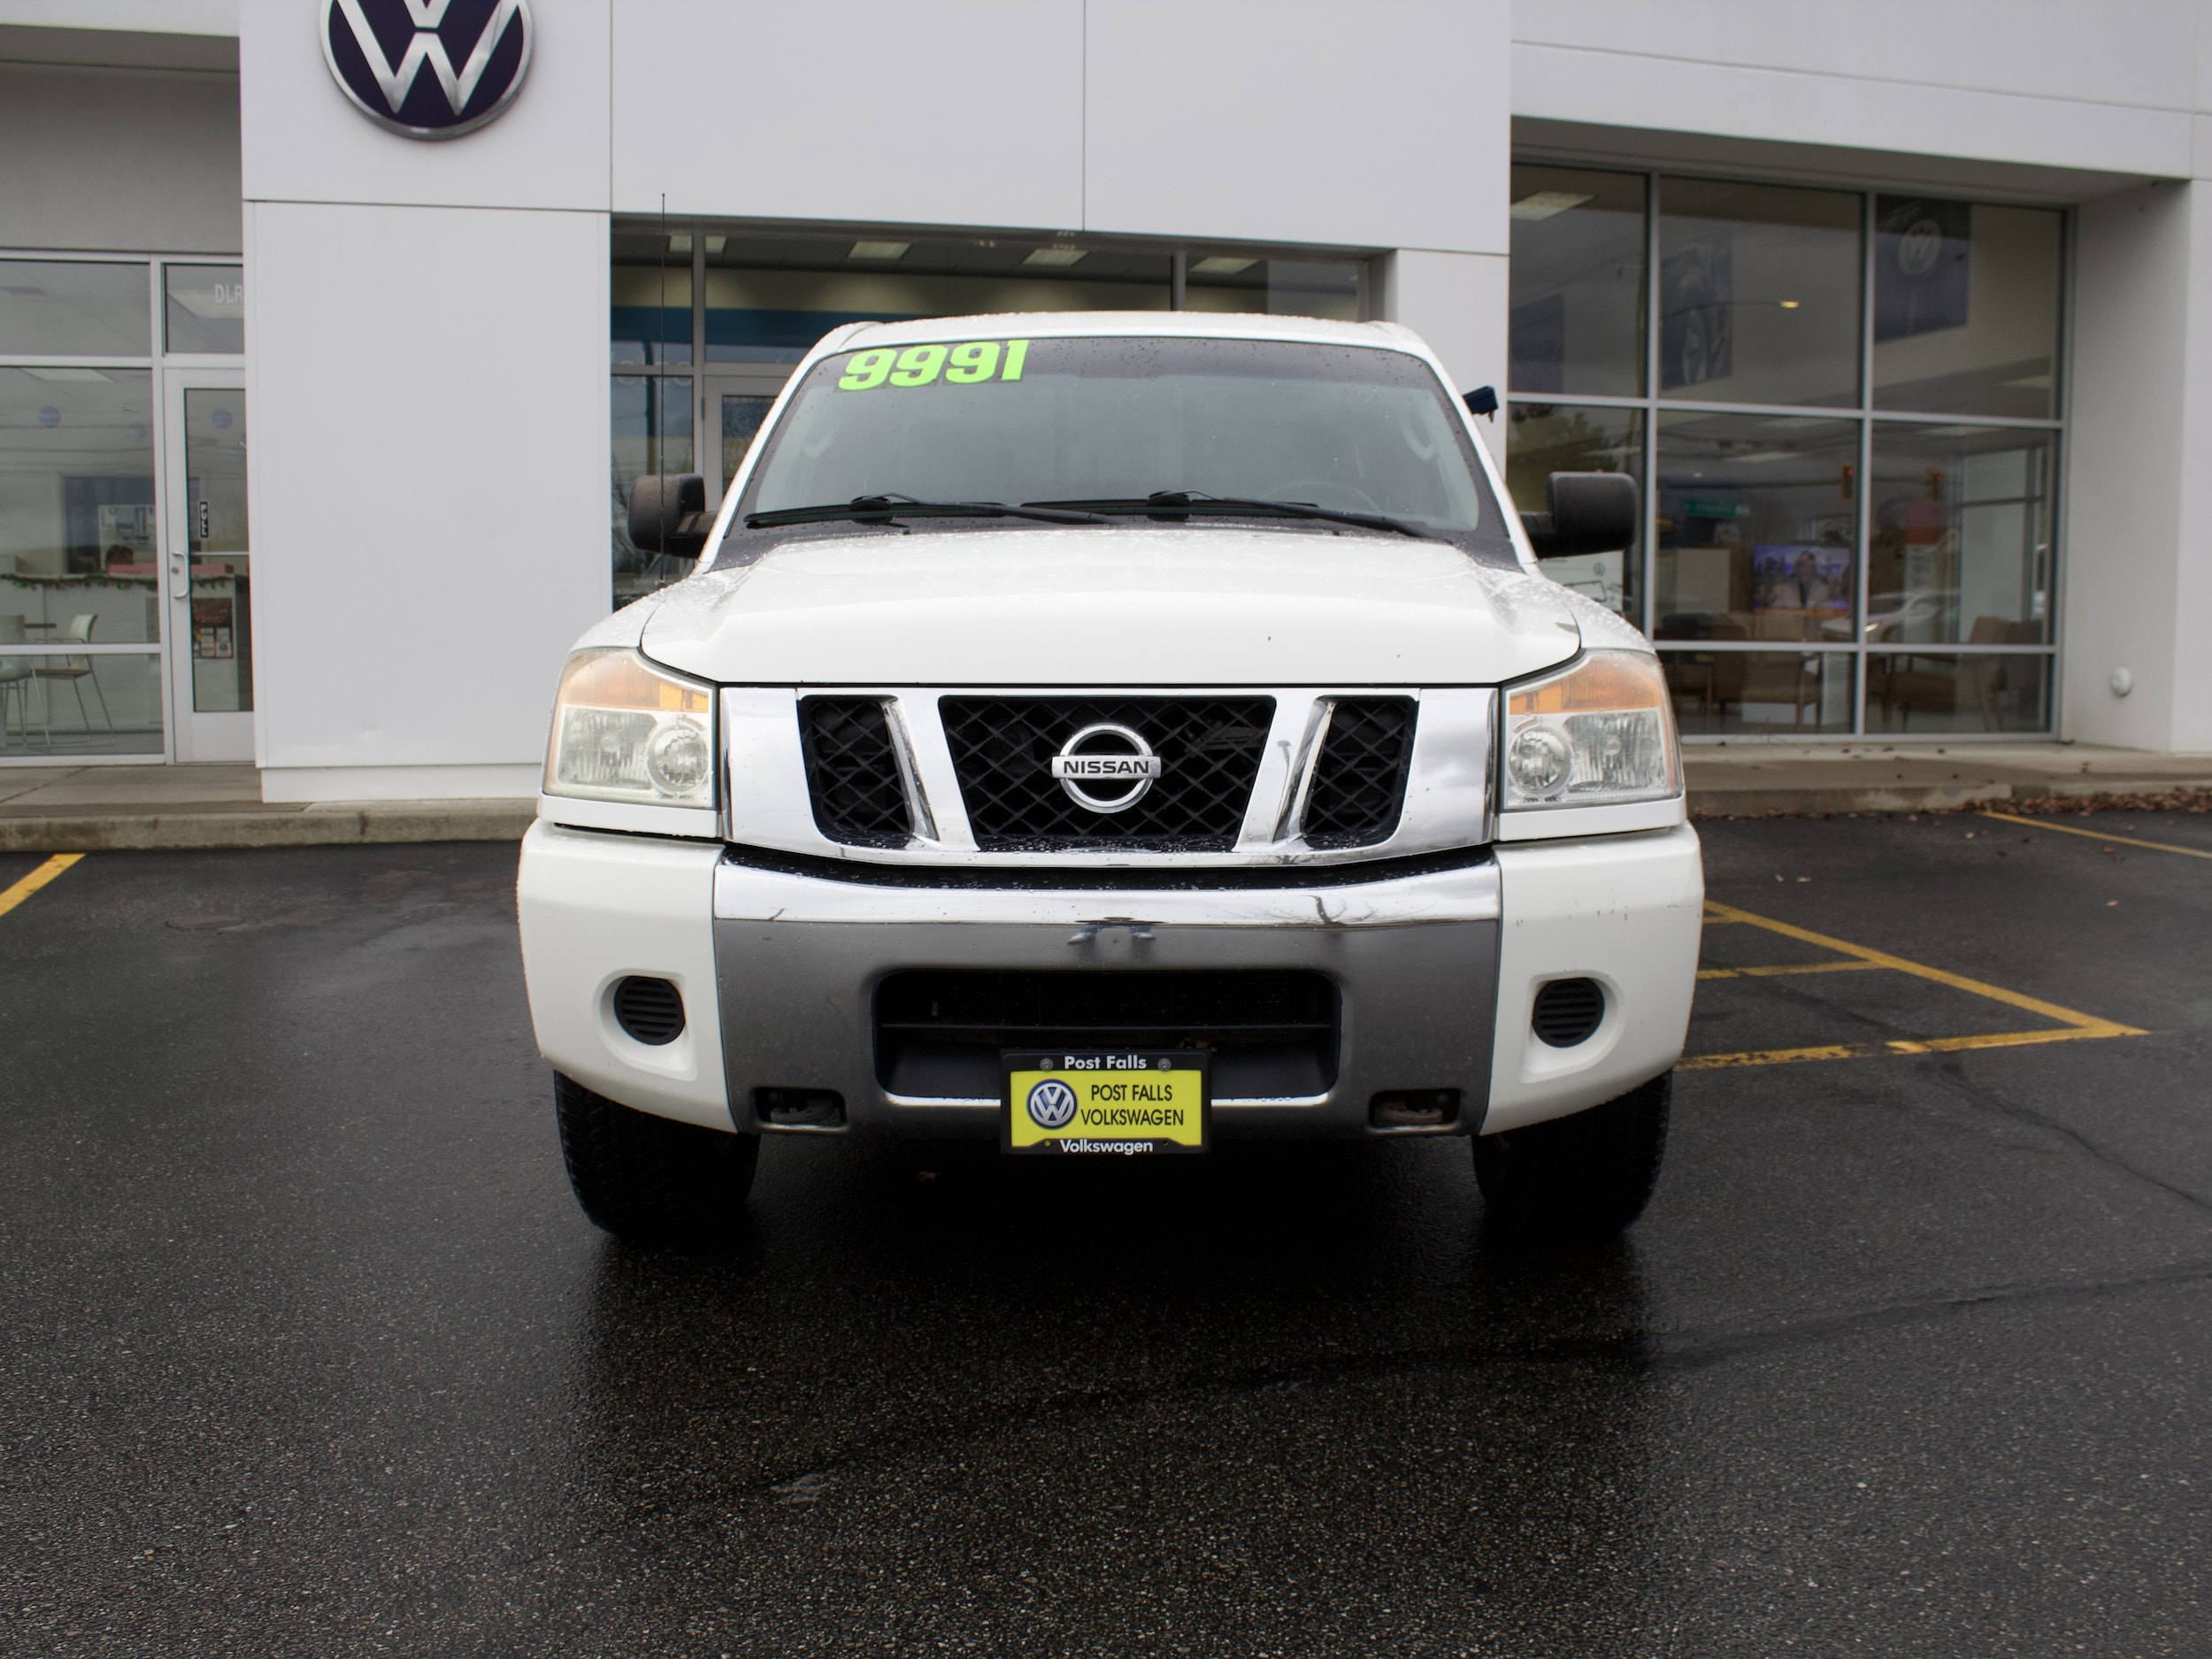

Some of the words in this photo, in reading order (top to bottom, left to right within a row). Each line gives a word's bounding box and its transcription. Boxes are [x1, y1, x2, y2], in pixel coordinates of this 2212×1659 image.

[838, 340, 1029, 390] 9991
[1064, 761, 1148, 773] NISSAN
[1064, 1056, 1101, 1070] Post
[1106, 1055, 1147, 1070] Falls
[1091, 1085, 1127, 1102] POST
[1132, 1085, 1172, 1102] FALLS
[1030, 1082, 1074, 1125] VW
[1080, 1109, 1184, 1125] VOLKSWAGEN
[1060, 1139, 1153, 1156] Volkswagen
